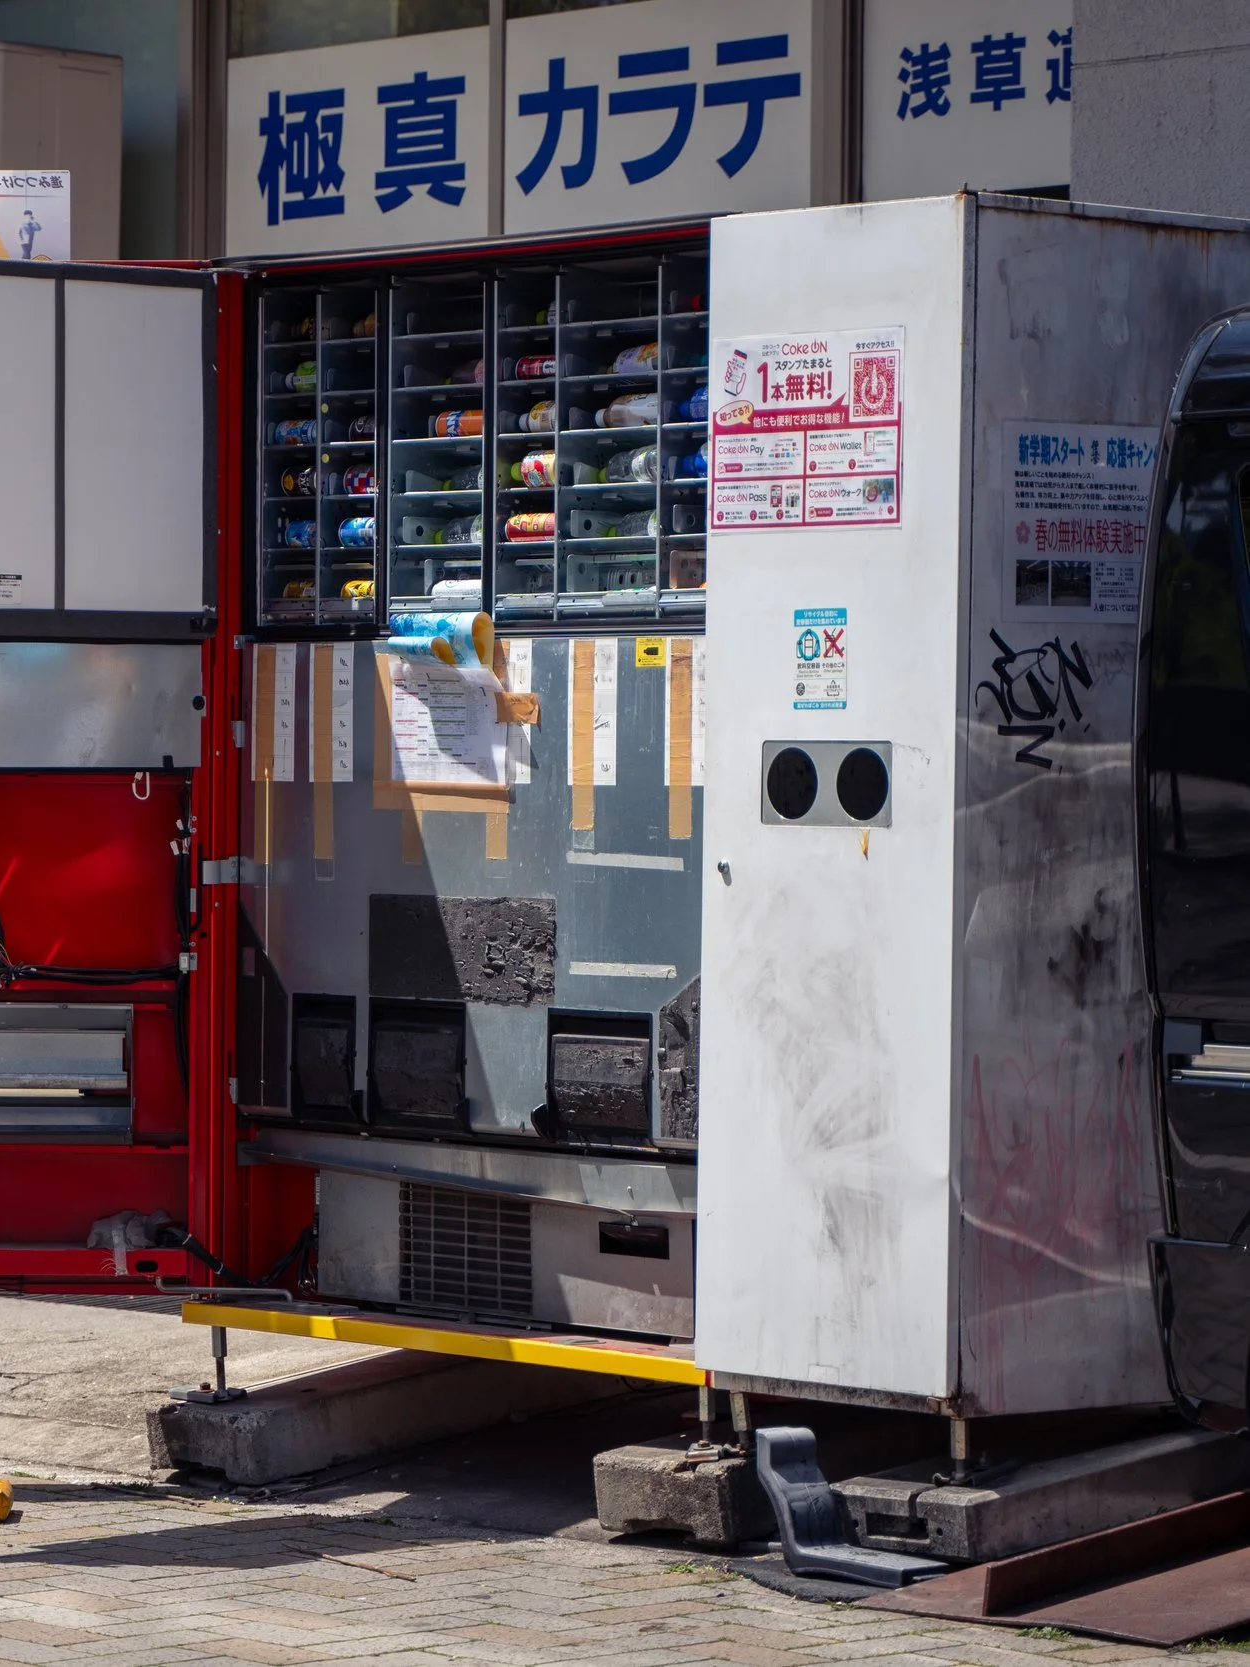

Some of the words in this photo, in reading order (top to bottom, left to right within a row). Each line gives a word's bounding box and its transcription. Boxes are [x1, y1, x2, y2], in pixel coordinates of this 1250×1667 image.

[257, 71, 466, 227] 極真
[515, 33, 801, 196] カラテ
[781, 342, 808, 356] Coke
[811, 339, 828, 354] ON
[774, 358, 832, 371] スタンプたまると
[757, 361, 833, 403] 1本無料!
[718, 445, 737, 455] Coke
[750, 444, 764, 456] Pay
[809, 442, 827, 452] Coke
[840, 441, 862, 451] Wallet
[1018, 433, 1085, 466] 新学期スタート
[717, 493, 735, 503] Coke
[749, 493, 767, 502] Pass
[809, 489, 828, 499] Coke
